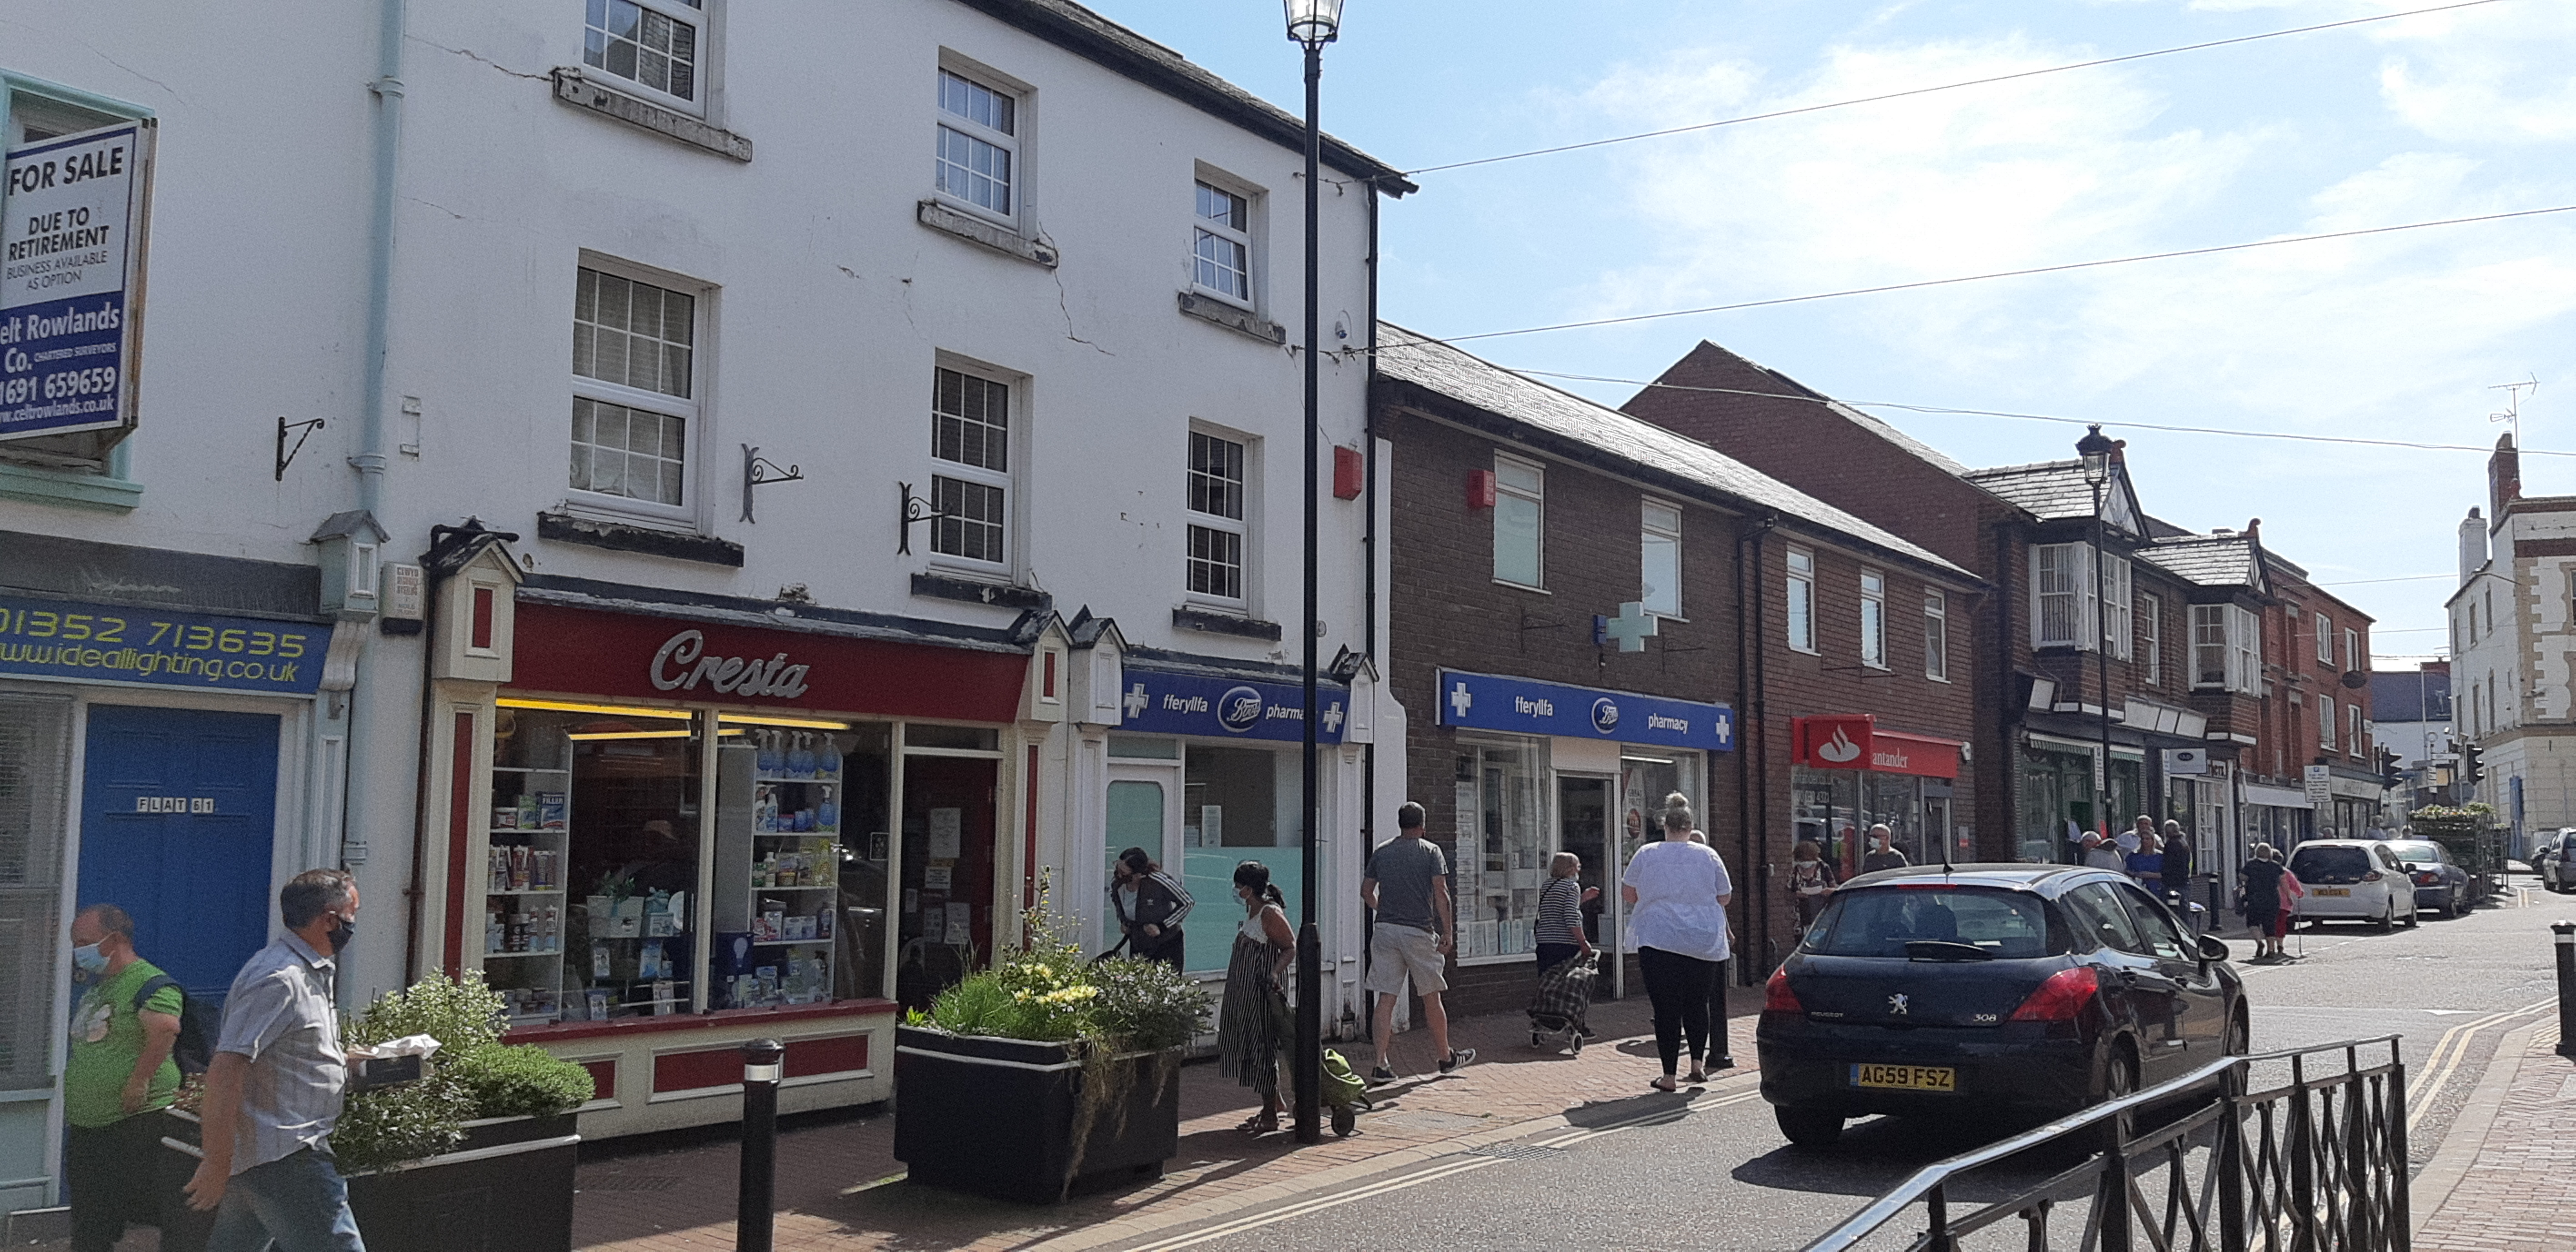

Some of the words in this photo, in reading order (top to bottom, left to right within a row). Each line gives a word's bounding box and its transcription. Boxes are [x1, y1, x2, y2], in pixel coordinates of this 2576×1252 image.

[9, 161, 56, 196] FOR
[64, 146, 123, 184] SALE
[28, 212, 62, 235] DUE
[68, 207, 89, 228] TO
[8, 225, 109, 261] RETIREMENT
[7, 260, 51, 280] BUSINESS
[55, 251, 107, 270] AVAILABLE
[26, 278, 39, 290] AS
[41, 270, 82, 288] OPTION
[0, 317, 22, 344] elt
[27, 301, 120, 340] Rowlands
[5, 347, 32, 373] Co.
[45, 366, 116, 399] 659659
[146, 621, 307, 658] 713635
[0, 642, 299, 682] ww.ideallighting.co.uk
[650, 630, 810, 698] Cresta
[1163, 694, 1208, 714] fferyllfa
[1266, 704, 1305, 719] pharma
[1515, 696, 1553, 718] fferyllfa
[1649, 712, 1688, 734] pharmacy
[1872, 747, 1908, 768] antander
[139, 799, 184, 811] FLAT
[1973, 1014, 1997, 1022] 308
[1862, 1065, 1908, 1085] AG59
[1914, 1068, 1950, 1087] FSZ
